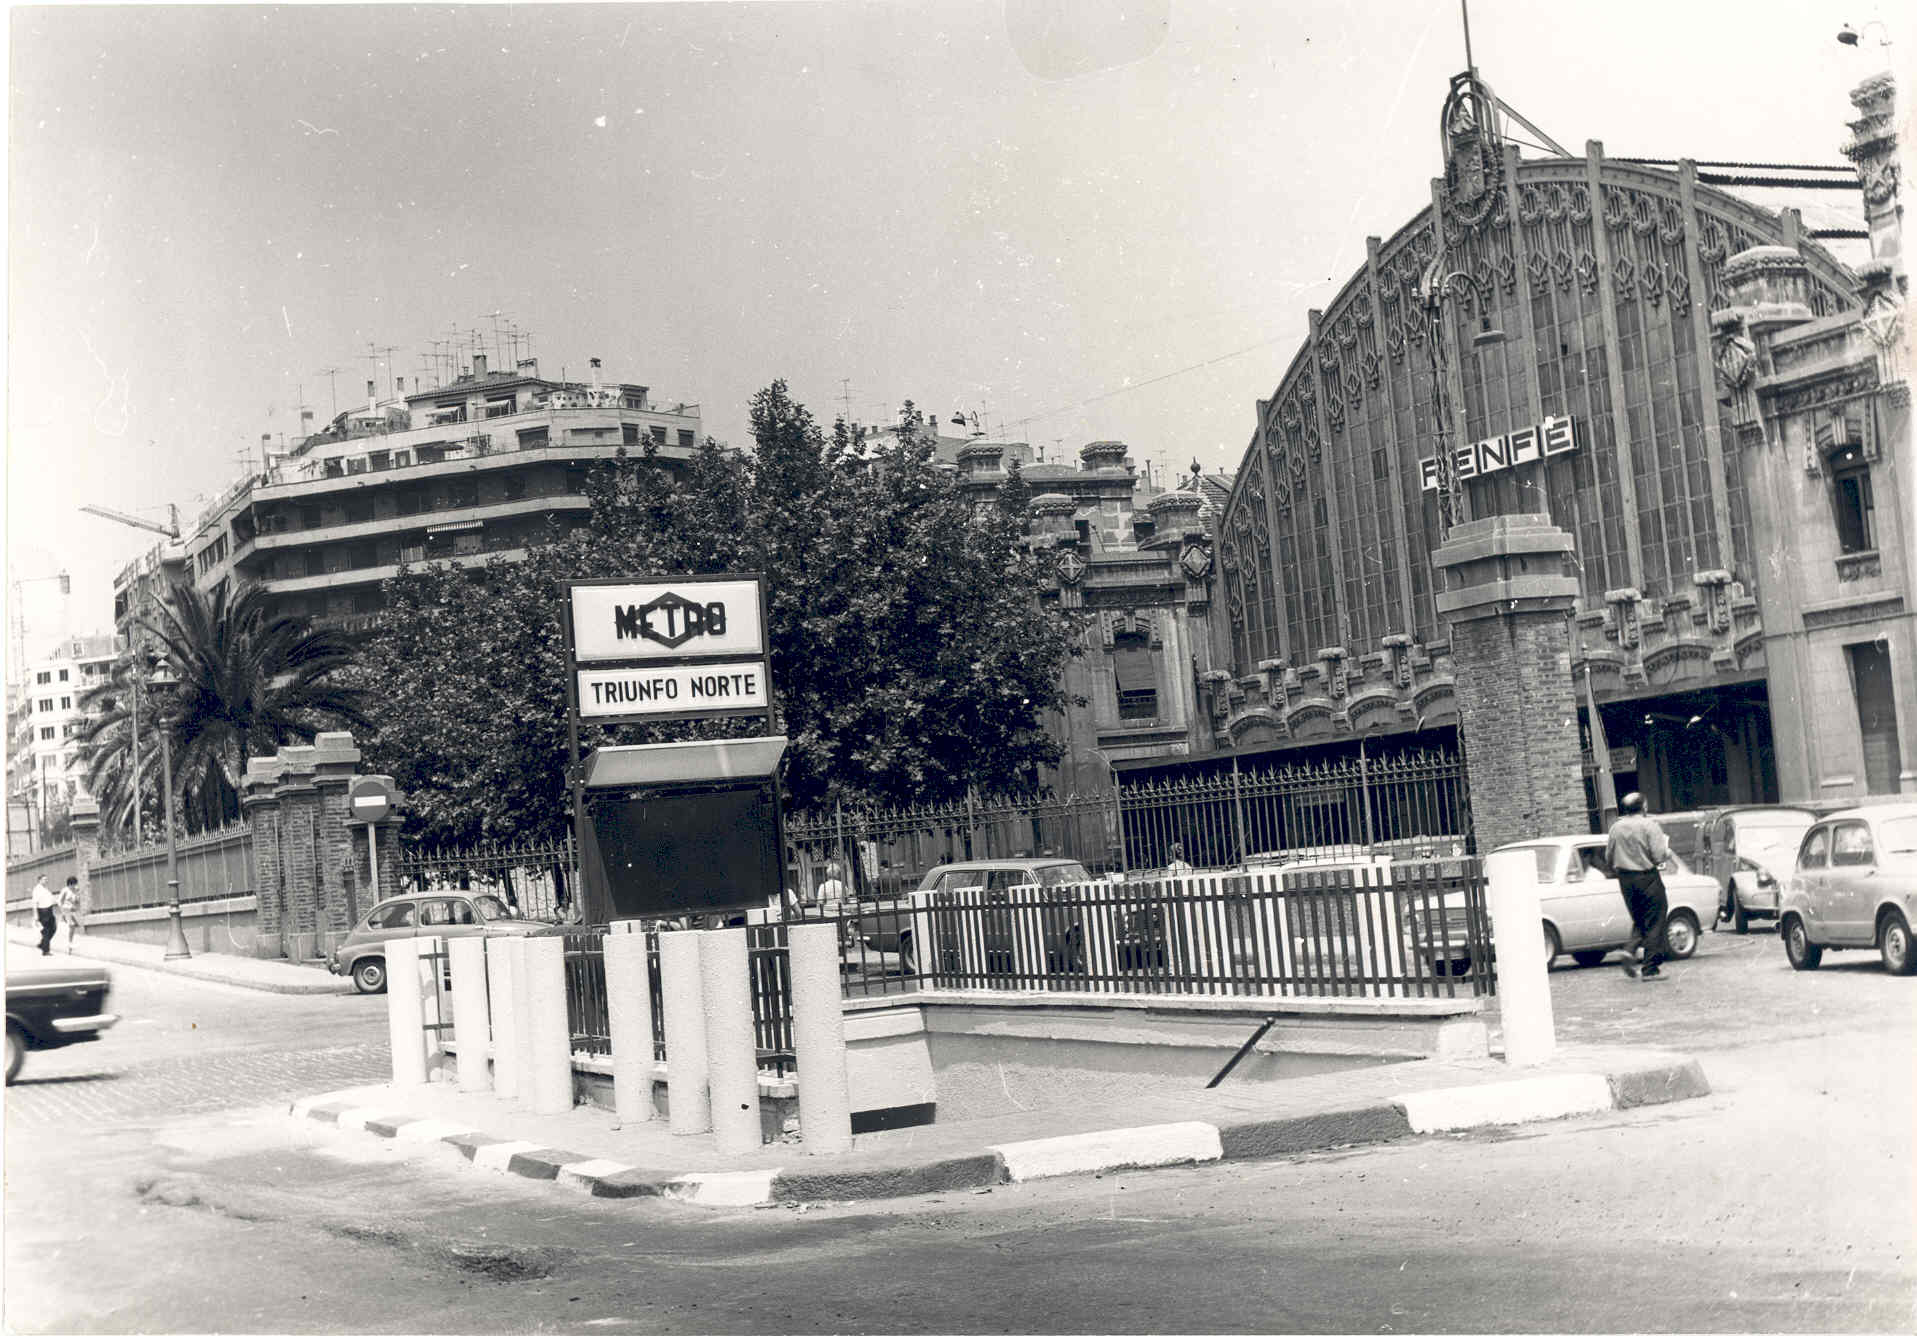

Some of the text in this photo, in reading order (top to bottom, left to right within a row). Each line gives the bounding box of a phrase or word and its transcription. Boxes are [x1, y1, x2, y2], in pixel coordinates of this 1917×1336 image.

[615, 602, 726, 639] METRO
[591, 674, 756, 704] TRIUNFO NORTE
